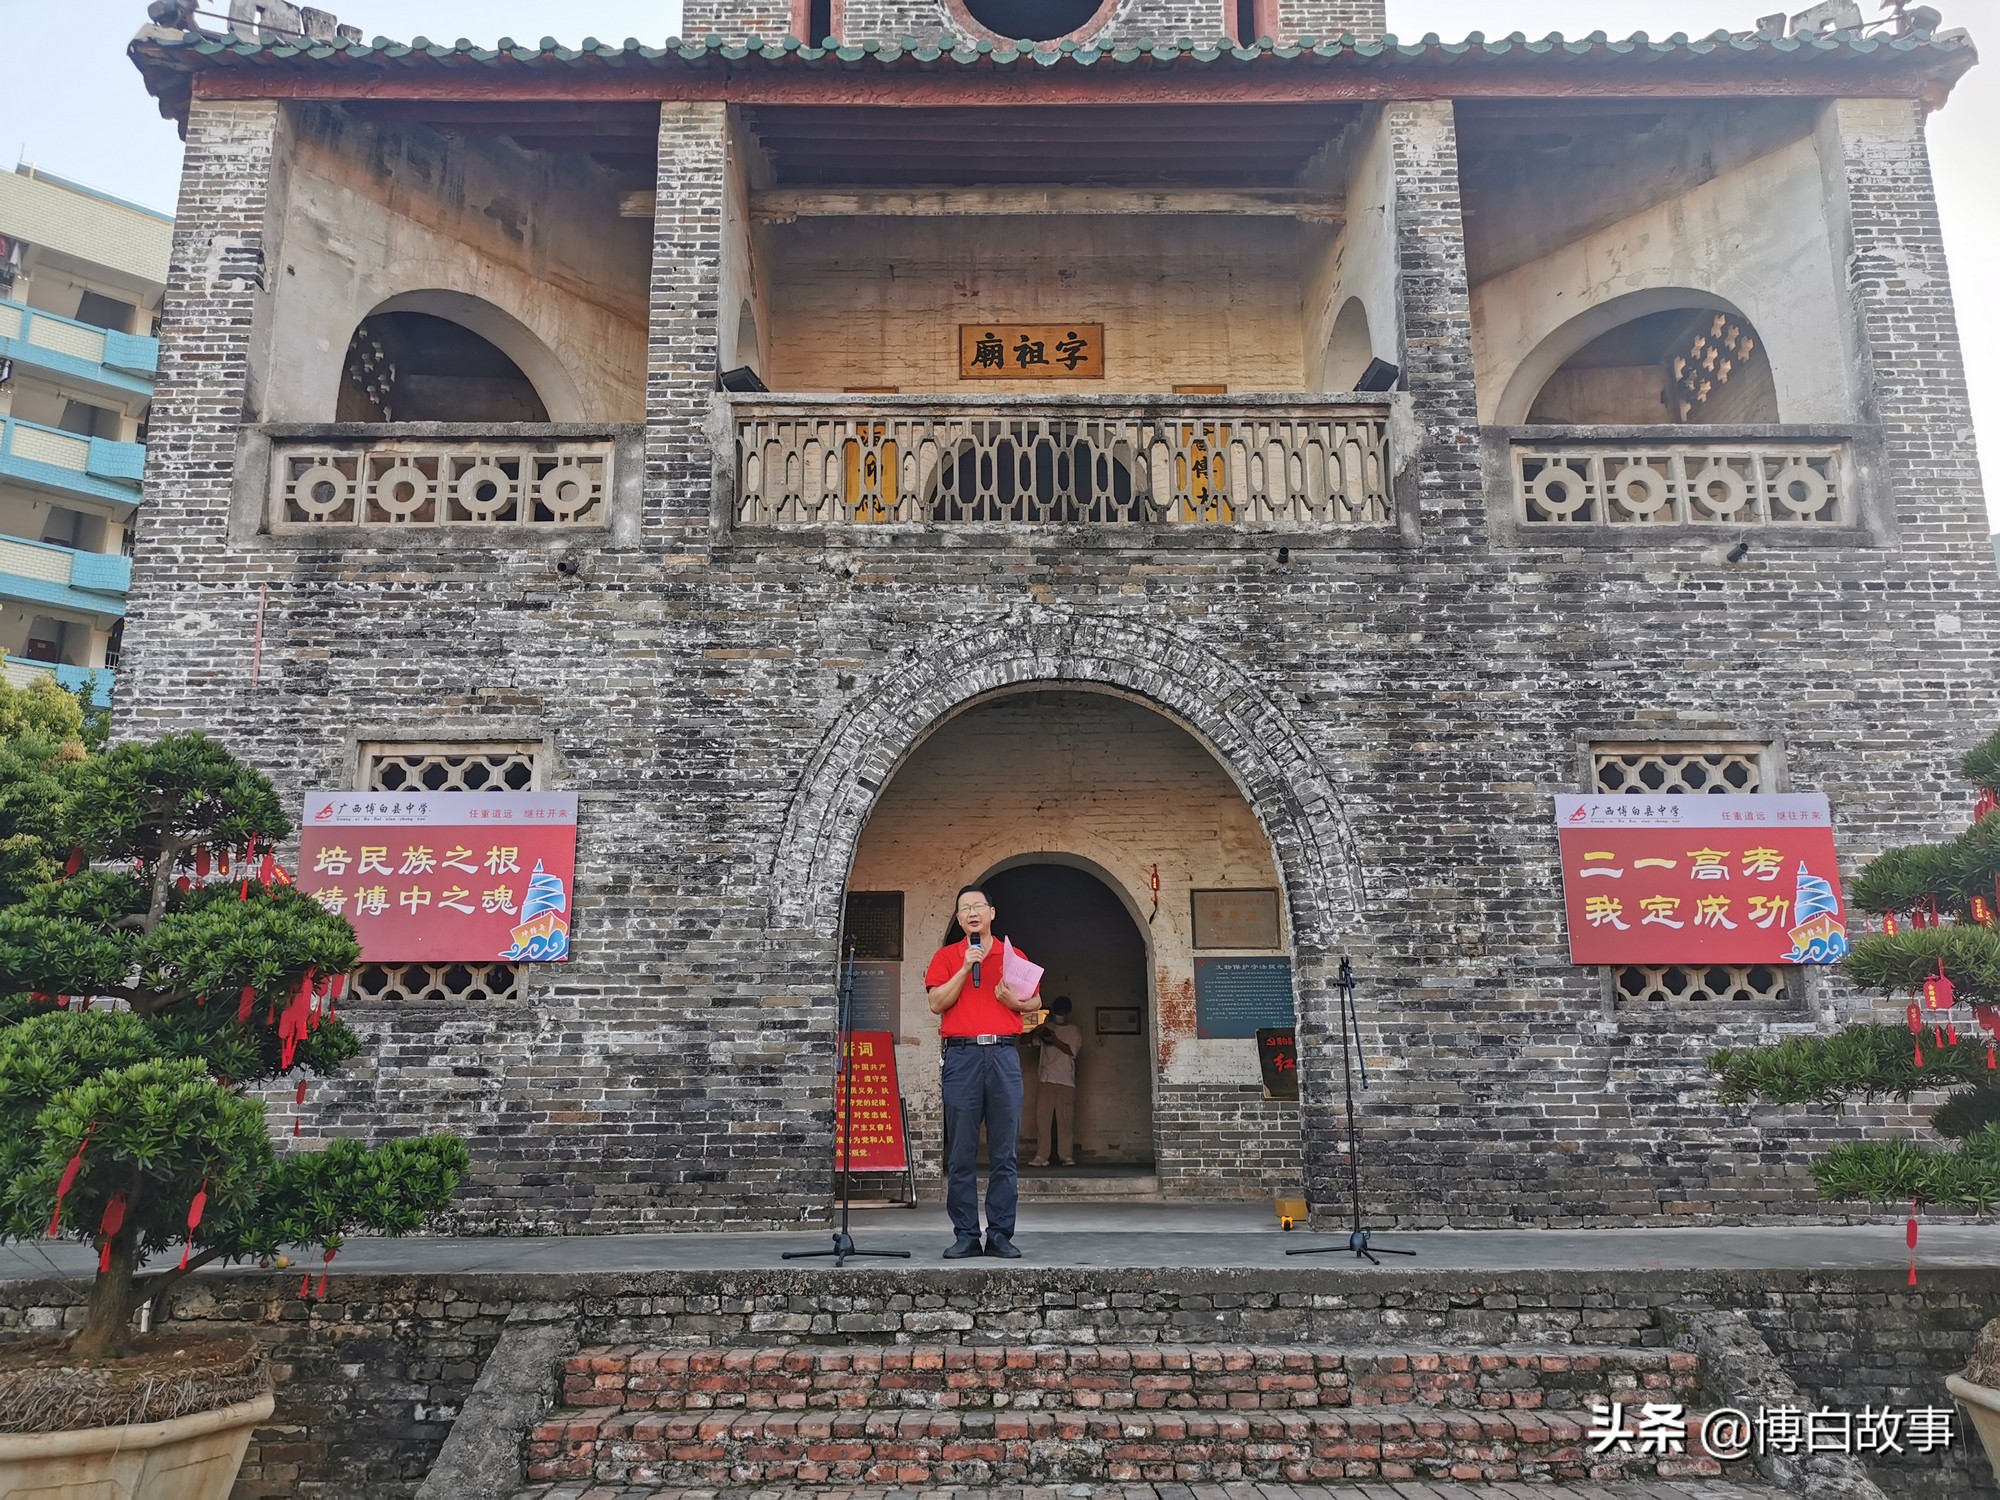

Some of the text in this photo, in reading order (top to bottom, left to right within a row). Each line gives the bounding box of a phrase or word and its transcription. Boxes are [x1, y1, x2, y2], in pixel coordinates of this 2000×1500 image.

[338, 802, 428, 815] 广西博白县中学
[470, 808, 568, 819] 任重道远 继往开来
[1591, 805, 1679, 817] 广西博白县中学
[1722, 810, 1821, 821] 任重道远 继往开来
[313, 844, 521, 876] 培民族之根
[1580, 846, 1785, 881] 二一高考
[312, 884, 518, 916] 铸博中之魂
[1584, 894, 1790, 931] 我定成功
[1273, 1053, 1296, 1073] 红
